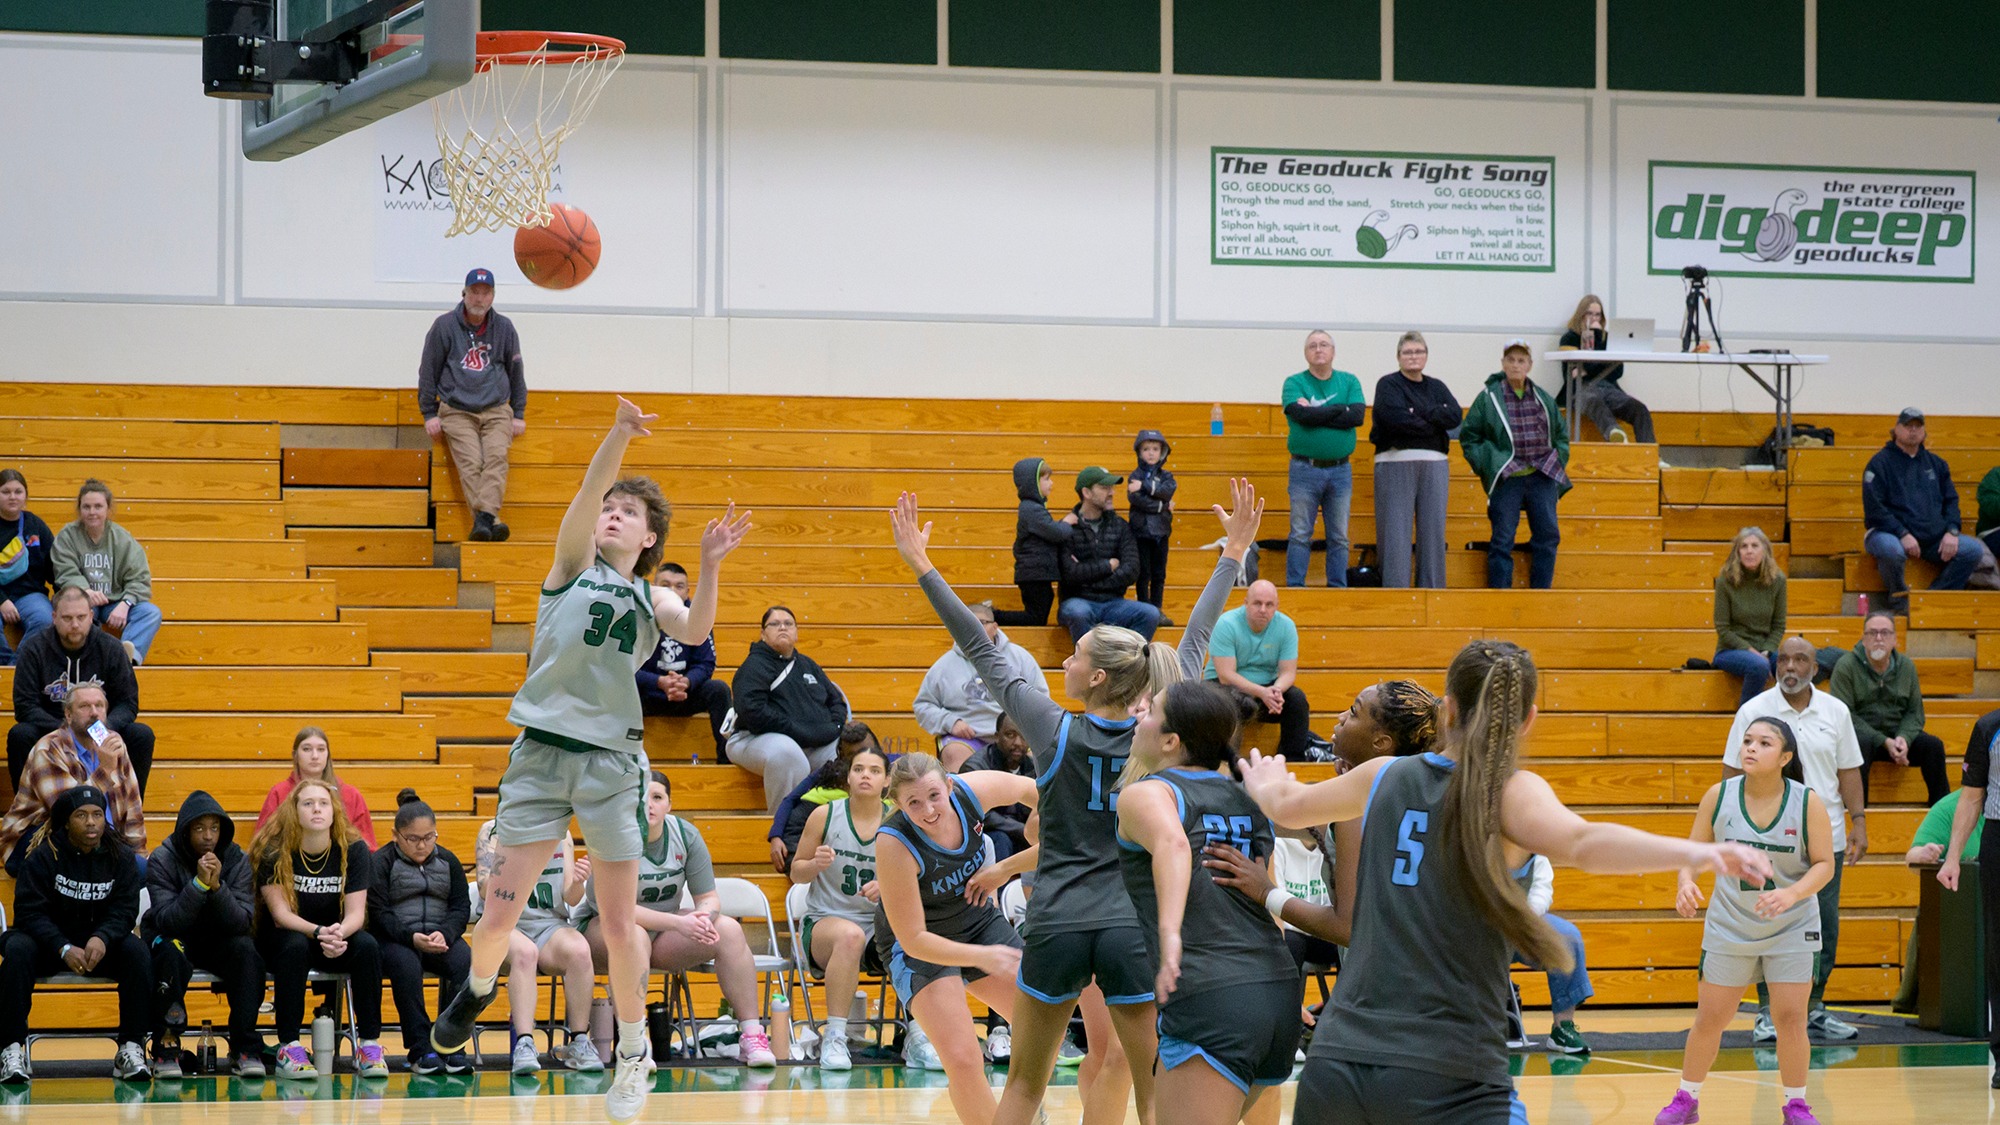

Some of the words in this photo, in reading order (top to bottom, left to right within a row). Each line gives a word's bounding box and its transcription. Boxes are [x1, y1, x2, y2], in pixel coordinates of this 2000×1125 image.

[1221, 157, 1268, 174] The
[1278, 158, 1393, 179] Geoduck
[1404, 162, 1473, 183] Fight
[1483, 164, 1548, 186] Song
[1221, 182, 1242, 192] GO,
[1246, 182, 1310, 193] GEODUCKS
[1314, 184, 1334, 195] GO,
[1435, 187, 1454, 198] GO,
[1459, 188, 1521, 198] GEODUCKS
[1525, 190, 1544, 200] GO,
[1824, 181, 1855, 193] the
[1861, 182, 1955, 197] evergreen
[1221, 195, 1261, 206] Through
[1265, 196, 1279, 205] the
[1283, 196, 1304, 205] mud
[1307, 197, 1325, 206] and
[1329, 197, 1343, 206] the
[1347, 198, 1371, 208] sand,
[1390, 200, 1424, 208] Stretch
[1428, 202, 1447, 211] your
[1451, 202, 1477, 210] necks
[1509, 203, 1523, 211] the
[1527, 203, 1545, 212] tide
[1842, 195, 1894, 208] state
[1900, 197, 1965, 212] college
[1221, 208, 1240, 216] let's
[1244, 211, 1259, 219] go.
[1516, 215, 1523, 224] is
[1526, 216, 1544, 224] low.
[1221, 220, 1254, 231] Siphon
[1257, 221, 1280, 232] high,
[1283, 222, 1310, 232] squirt
[1313, 222, 1319, 231] it
[1322, 224, 1341, 233] out,
[1427, 226, 1458, 236] Siphon
[1462, 226, 1484, 237] high,
[1488, 228, 1514, 237] squirt
[1517, 228, 1523, 236] it
[1527, 230, 1545, 238] out,
[1655, 193, 1770, 253] dig
[1796, 198, 1966, 266] deep
[1221, 233, 1251, 242] swivel
[1254, 234, 1264, 243] all
[1268, 234, 1298, 244] about,
[1470, 240, 1498, 248] swivel
[1502, 241, 1512, 249] all
[1516, 241, 1545, 250] about,
[1221, 246, 1239, 254] LET
[1242, 246, 1251, 255] IT
[1254, 247, 1272, 255] ALL
[1276, 248, 1307, 256] HANG
[1310, 248, 1333, 257] OUT.
[1436, 252, 1453, 260] LET
[1456, 252, 1464, 260] IT
[1468, 252, 1485, 260] ALL
[1489, 253, 1519, 261] HANG
[1523, 254, 1544, 262] OUT.
[1794, 247, 1915, 265] geoducks
[84, 553, 112, 569] DIDA
[583, 601, 637, 655] 34
[1391, 809, 1429, 887] 5
[931, 843, 987, 896] KNIGHT
[55, 882, 110, 901] basketb
[494, 887, 516, 901] 444
